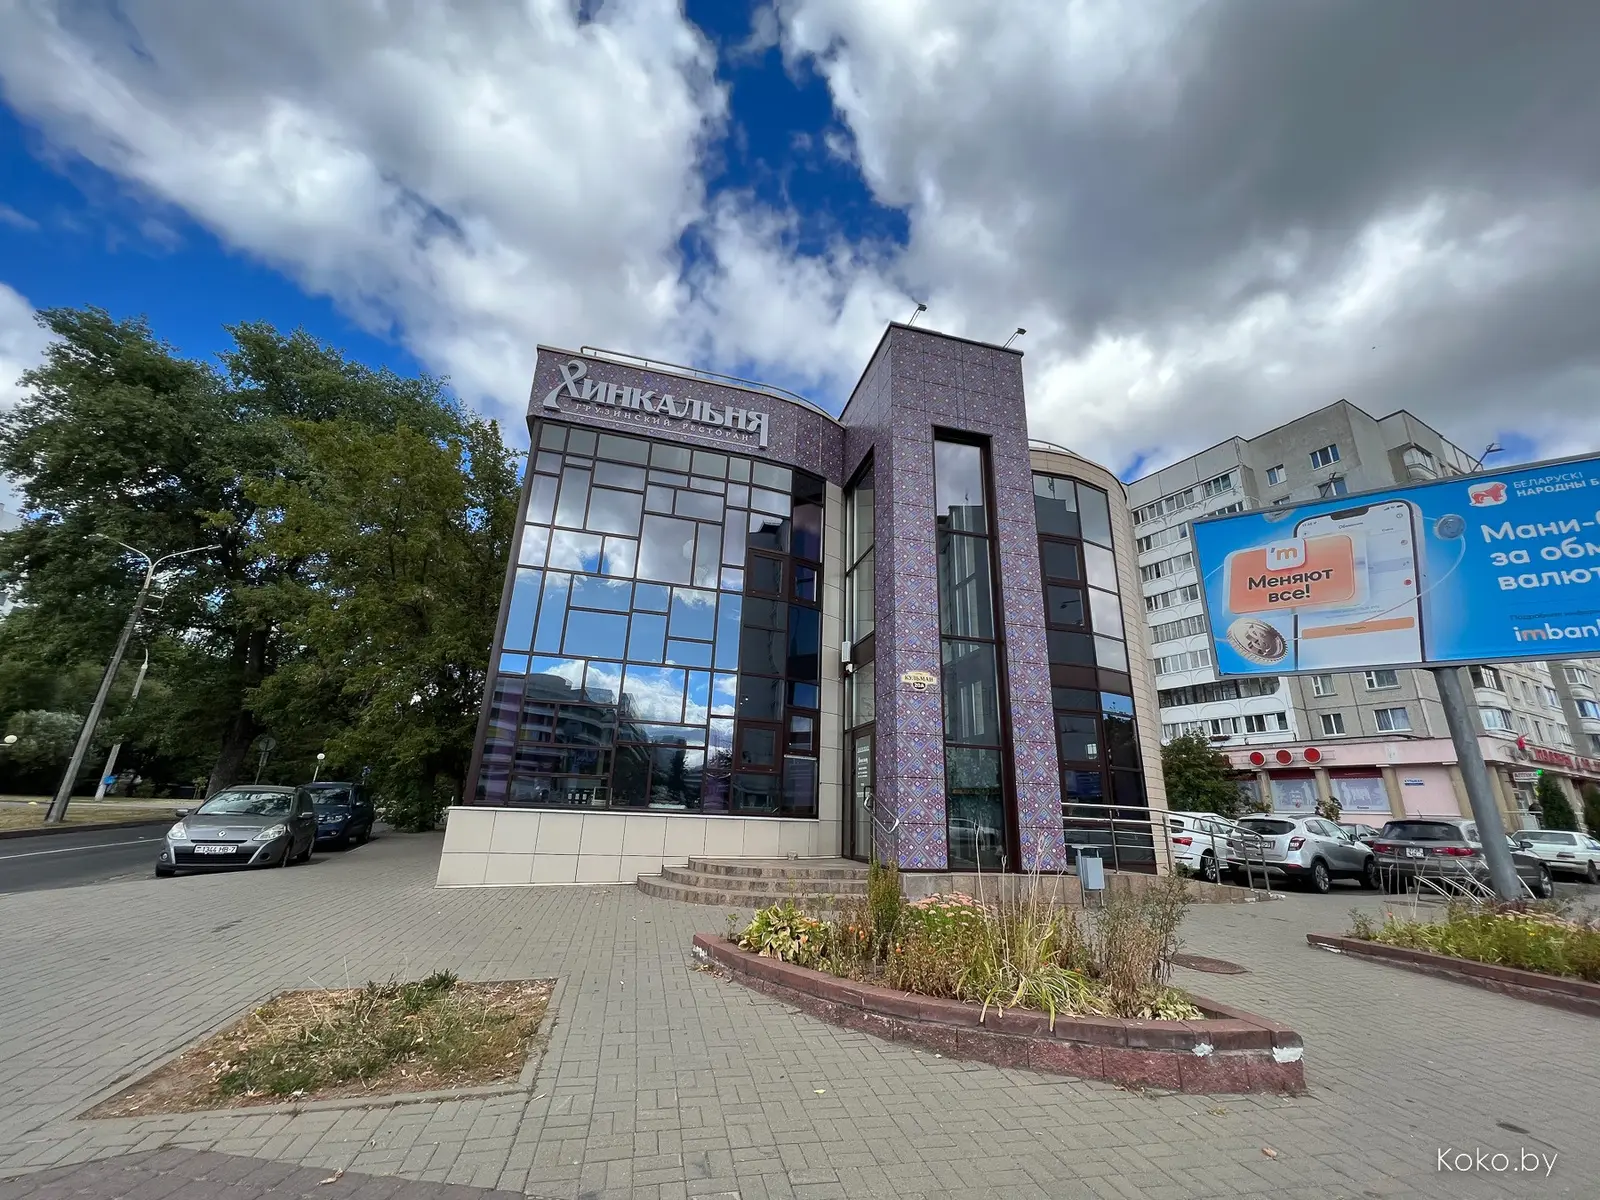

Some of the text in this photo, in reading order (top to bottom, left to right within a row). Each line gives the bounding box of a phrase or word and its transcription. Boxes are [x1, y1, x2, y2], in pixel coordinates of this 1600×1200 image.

[543, 360, 769, 447] ХИНКАЛЬНЯ
[575, 403, 750, 441] ГРУЗИНСКИЙ РЕСТОРАН
[1513, 472, 1583, 489] БЕЛАРУСКІ
[1516, 480, 1586, 497] НАРОДНЫ
[1490, 549, 1530, 566] за
[1248, 568, 1334, 591] Меняют
[1268, 583, 1311, 603] все!
